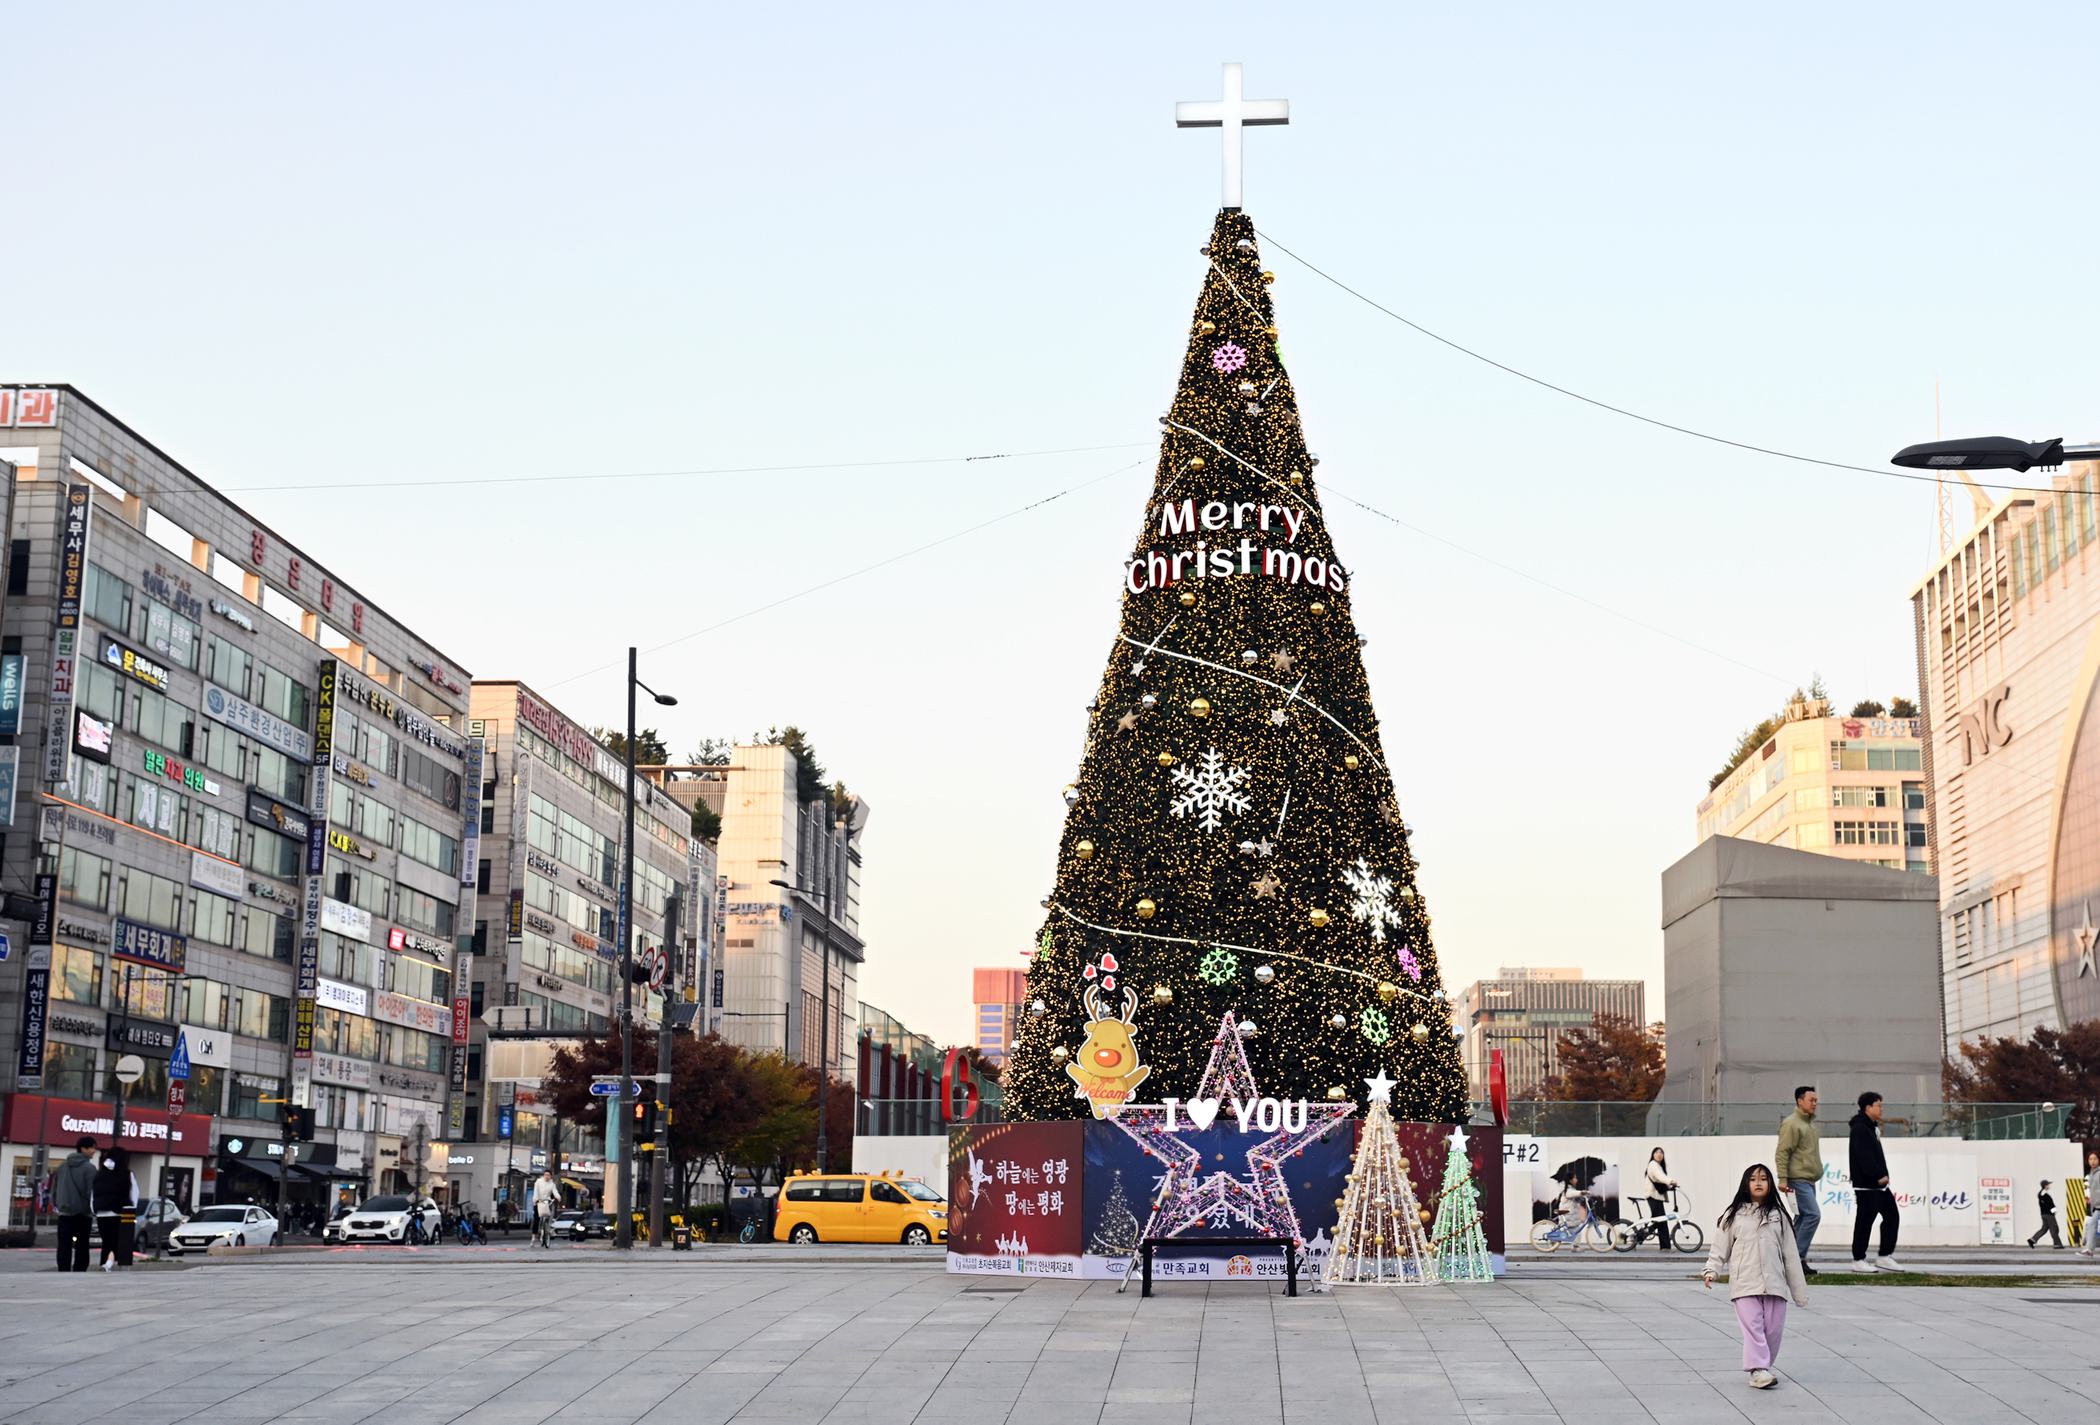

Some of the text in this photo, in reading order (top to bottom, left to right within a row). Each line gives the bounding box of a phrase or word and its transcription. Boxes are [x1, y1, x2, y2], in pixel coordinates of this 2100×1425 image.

[66, 505, 84, 552] 세무사
[1160, 498, 1305, 544] Merry
[155, 562, 192, 594] HI-TAX
[3, 662, 18, 711] wells
[53, 658, 73, 695] 치과
[1960, 684, 2012, 767] NC
[305, 879, 318, 930] 세무사 김정수
[124, 924, 172, 964] 세무회계
[299, 946, 316, 989] 세무회계
[24, 973, 45, 1068] 새한신용정보
[378, 995, 405, 1021] 아이조아
[455, 1000, 468, 1038] 아이조아
[296, 1025, 311, 1050] 산재
[452, 1047, 465, 1083] 세계주류
[170, 1087, 185, 1102] 정지
[1075, 1080, 1135, 1101] Welcome
[169, 1103, 183, 1116] STOP
[1162, 1097, 1308, 1134] I YOU
[996, 1158, 1069, 1185] 하늘에는 영광
[1005, 1190, 1064, 1216] 땅에는 평화
[1931, 1191, 1974, 1210] 안산
[978, 1258, 1012, 1270] 초지순복음교회
[1038, 1261, 1074, 1274] 안산제자교회
[1163, 1262, 1210, 1276] 만족교회
